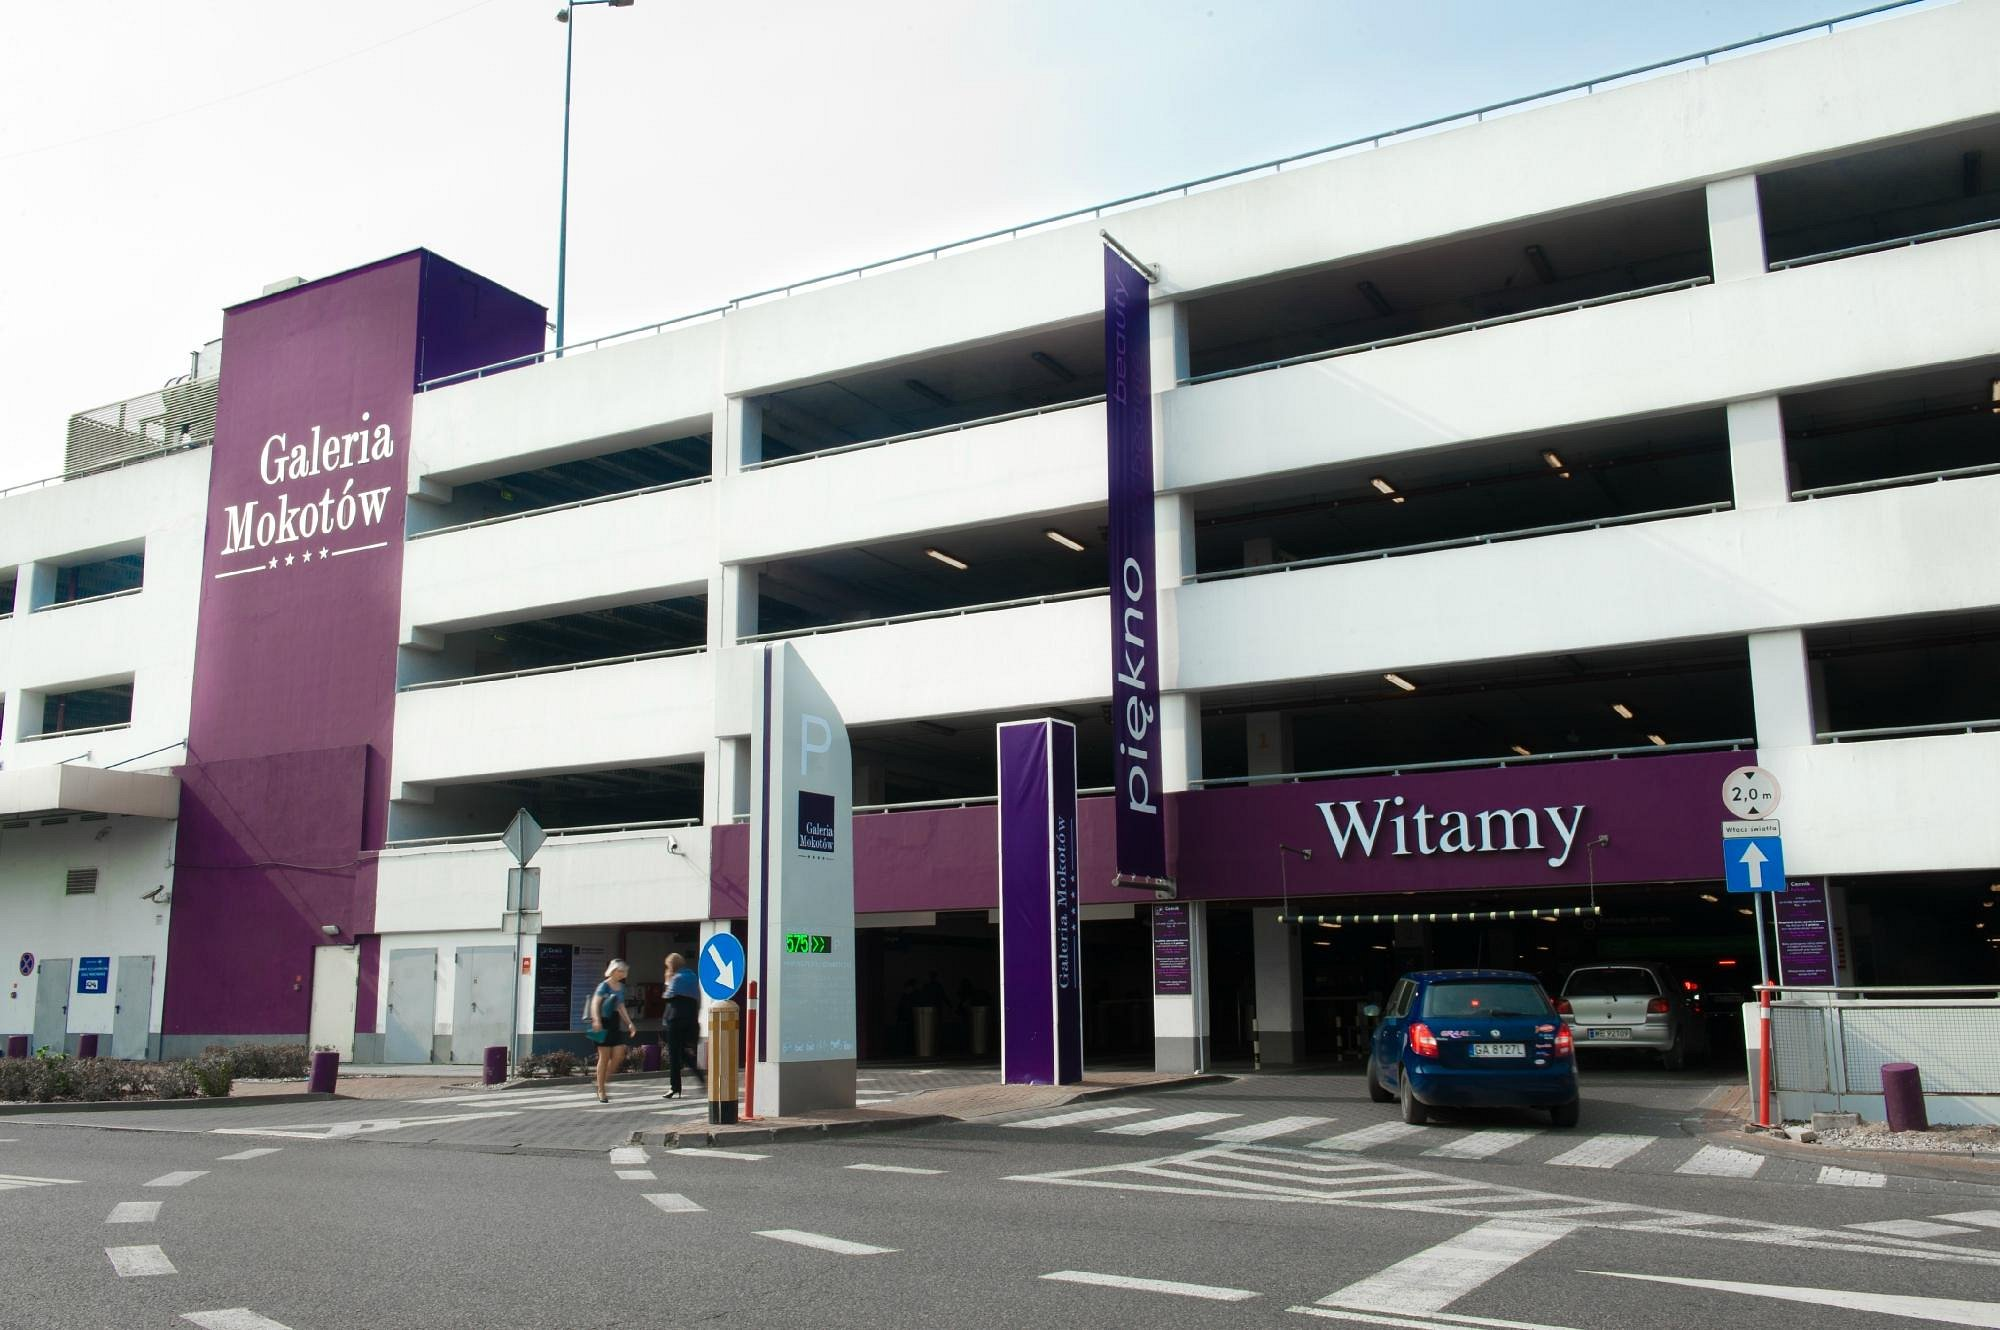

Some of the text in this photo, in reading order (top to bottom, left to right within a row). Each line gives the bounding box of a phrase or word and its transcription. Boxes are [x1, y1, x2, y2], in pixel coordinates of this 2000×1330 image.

[1112, 274, 1129, 405] beauty
[260, 411, 394, 485] Galeria
[220, 478, 392, 556] Mokotów
[1117, 557, 1158, 815] piękno
[801, 713, 832, 776] P
[806, 822, 834, 837] Galeria
[1732, 786, 1758, 803] 2,0
[800, 834, 834, 851] Mokotów
[1315, 796, 1586, 868] Witamy
[1056, 815, 1069, 989] Galeria Mokotów
[786, 934, 809, 953] 575
